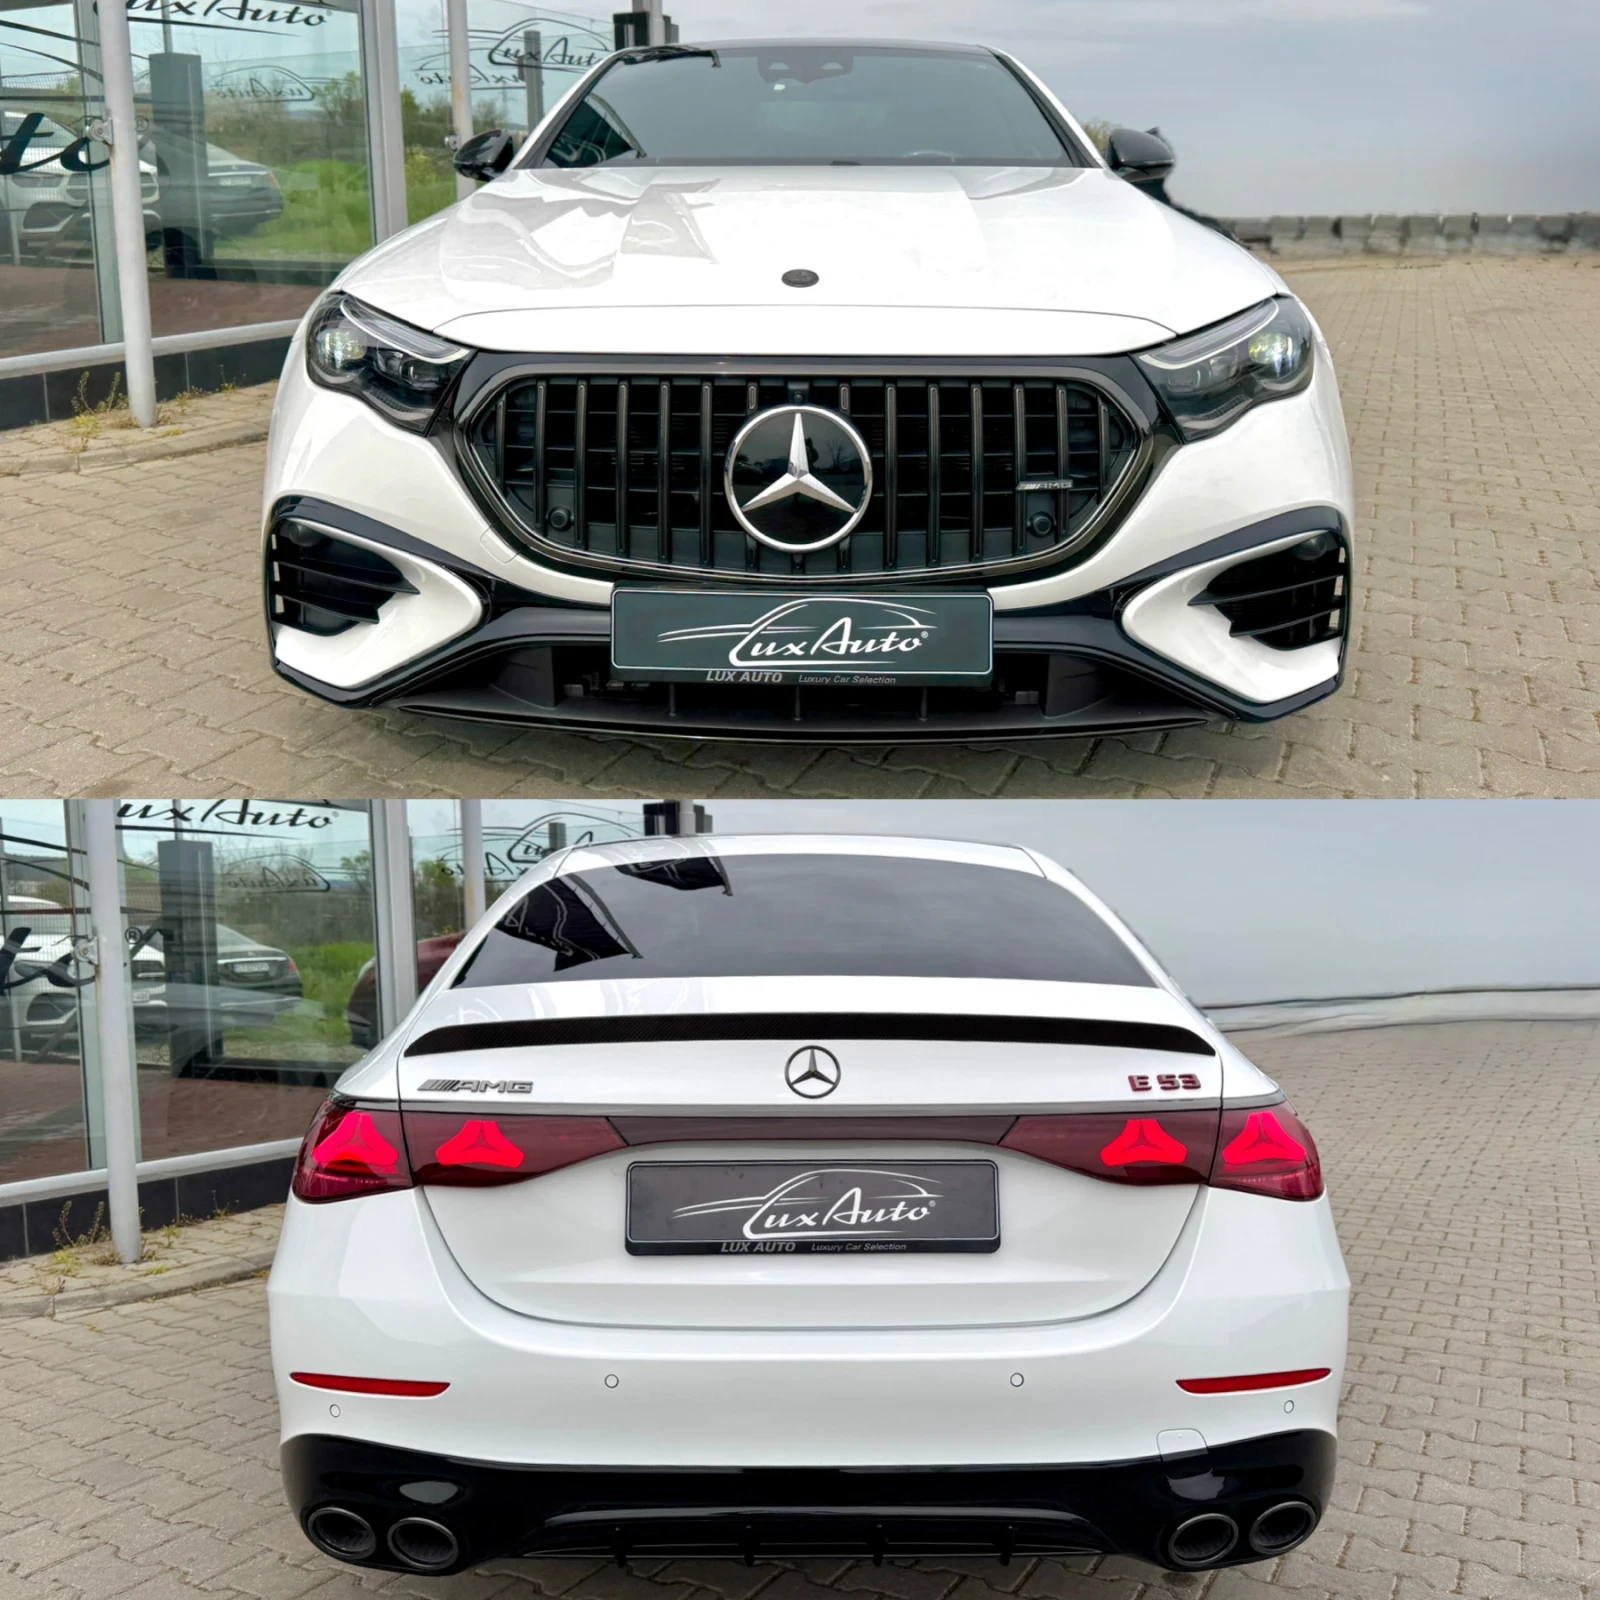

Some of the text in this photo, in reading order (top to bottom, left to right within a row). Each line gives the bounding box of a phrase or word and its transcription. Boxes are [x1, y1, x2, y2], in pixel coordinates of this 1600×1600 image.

[544, 37, 602, 65] Aut
[706, 670, 897, 685] LUX AUTO Luxury Car Selection
[451, 1079, 534, 1094] AMG
[1128, 1073, 1201, 1092] E 53
[720, 1241, 907, 1253] LUX AUTO Luxury Car Selection
